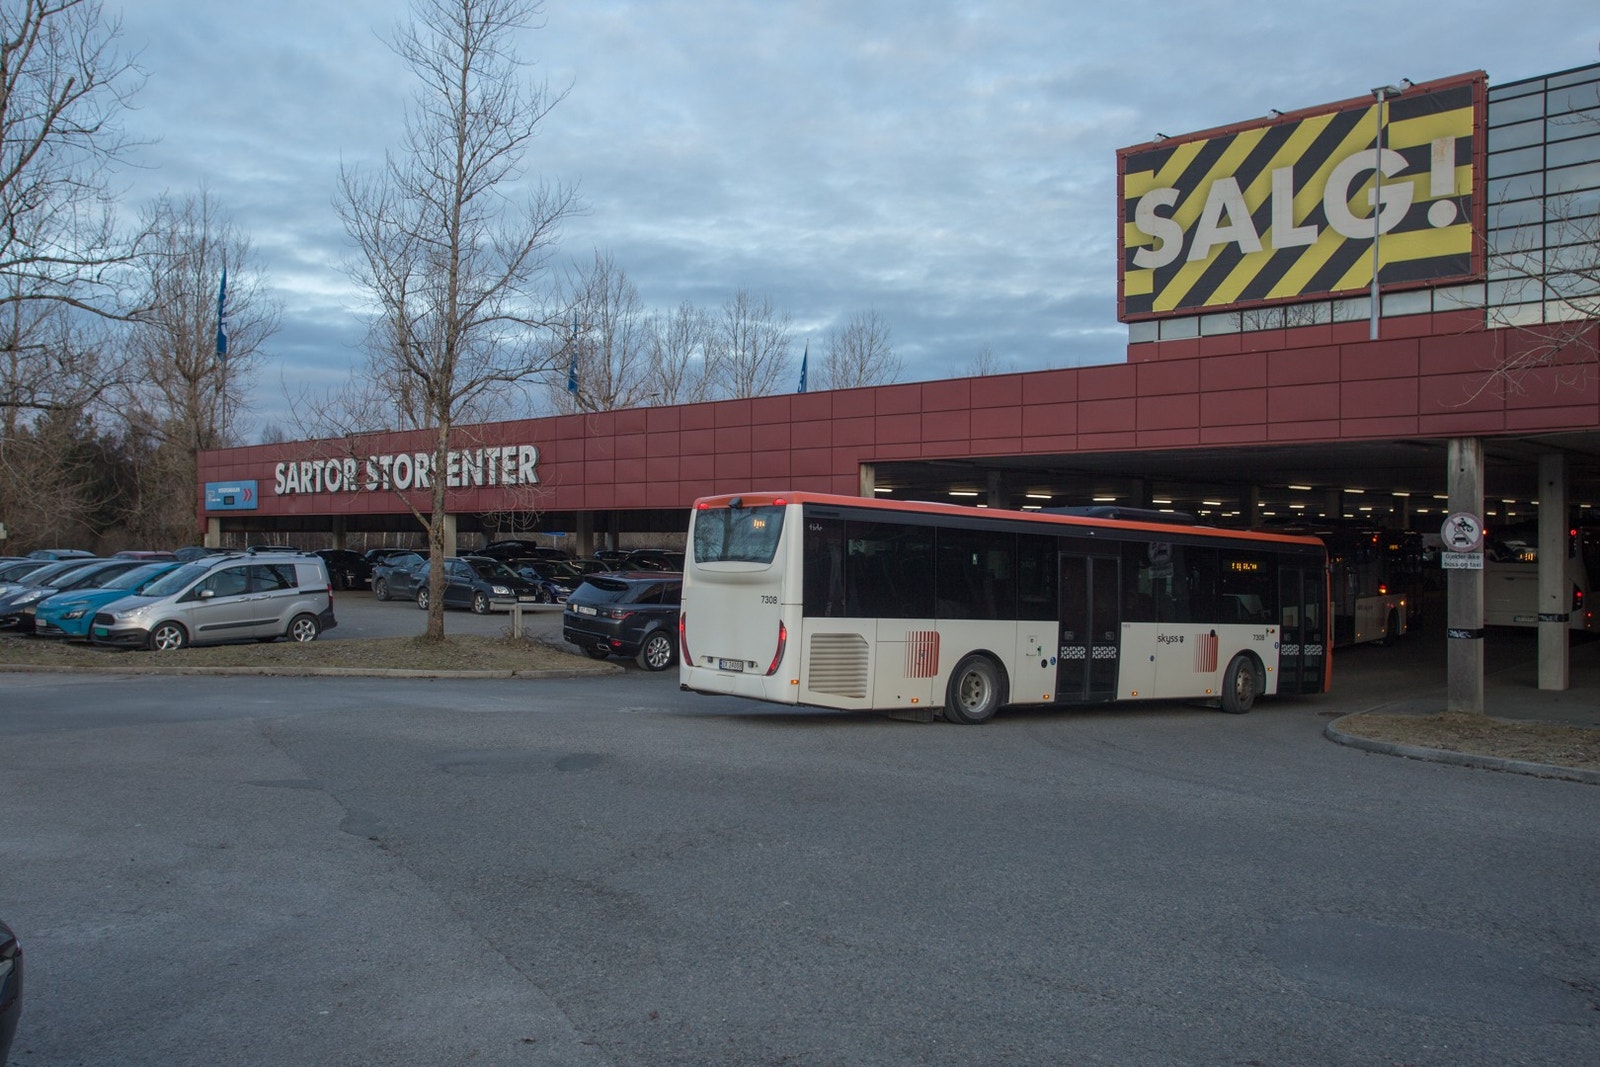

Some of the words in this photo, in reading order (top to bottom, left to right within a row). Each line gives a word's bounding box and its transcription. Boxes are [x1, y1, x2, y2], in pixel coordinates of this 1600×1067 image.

[1132, 136, 1458, 269] SALG!
[274, 456, 359, 495] SARTOR
[761, 595, 777, 604] 7308
